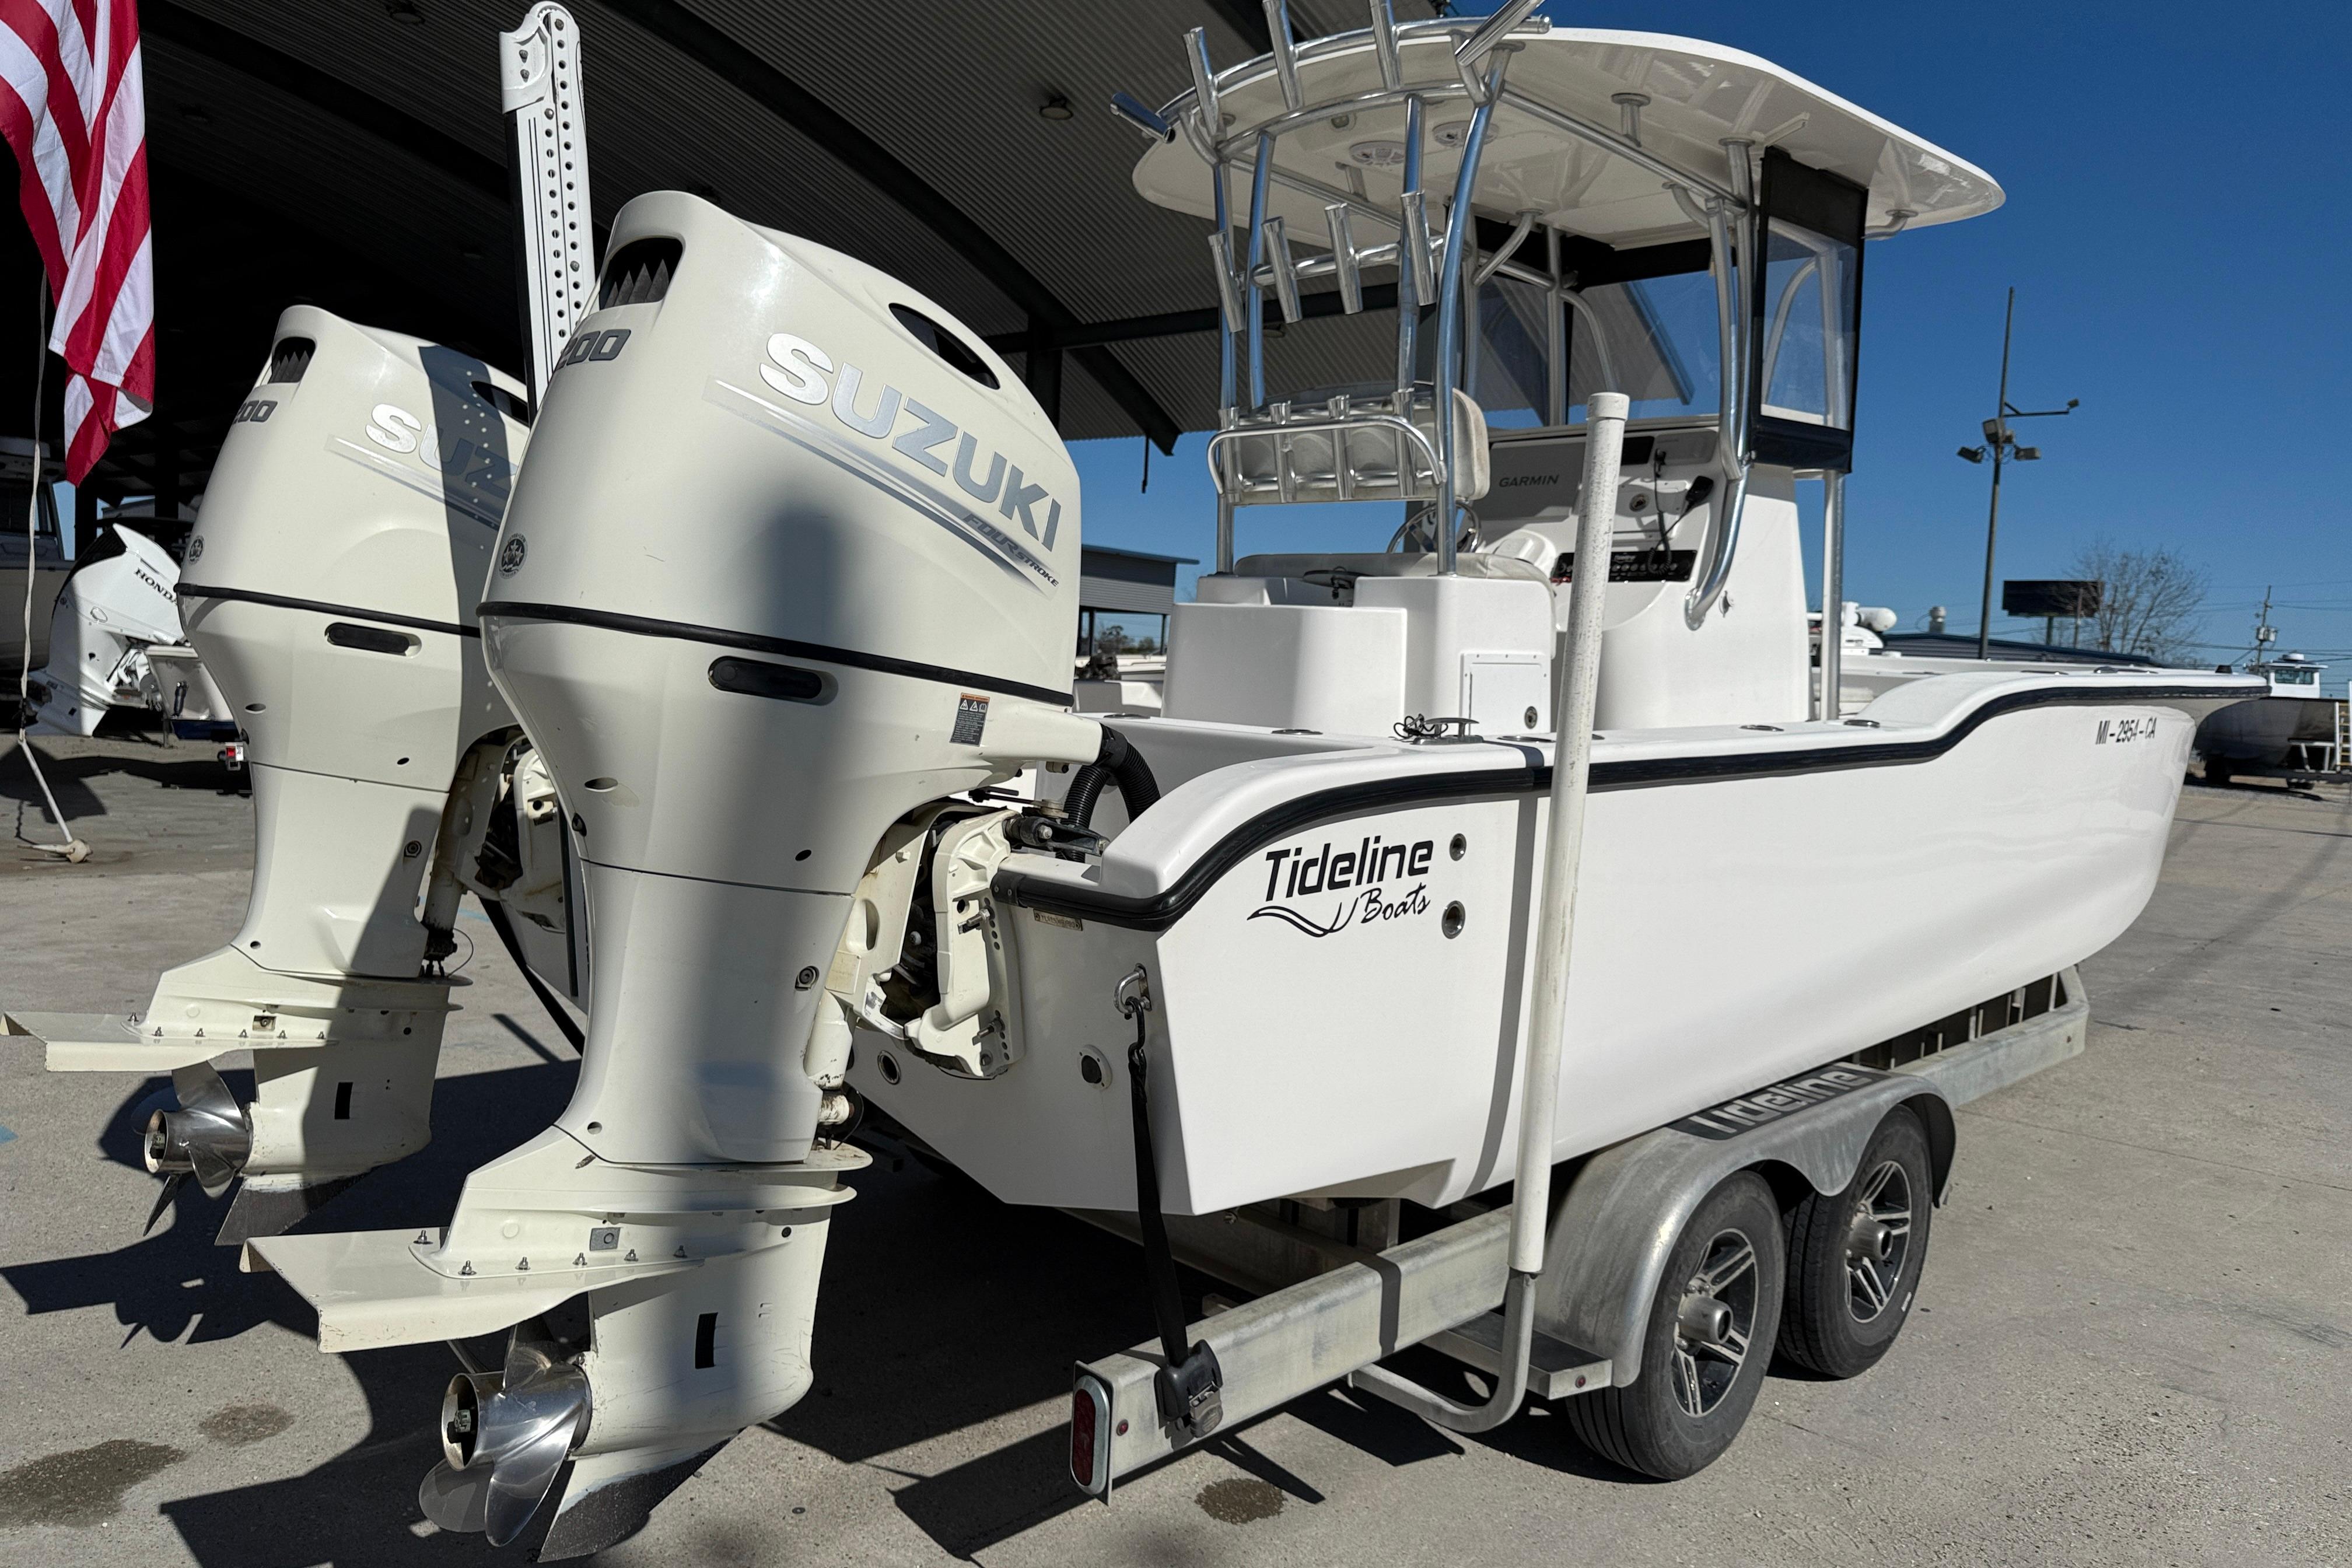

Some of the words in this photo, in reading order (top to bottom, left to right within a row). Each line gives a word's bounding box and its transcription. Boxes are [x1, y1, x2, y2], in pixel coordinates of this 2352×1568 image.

[759, 332, 1061, 552] SUZUKI
[1499, 474, 1560, 488] GARMIN
[963, 513, 1019, 554] FOUR
[1015, 552, 1059, 587] STROKE
[1265, 835, 1434, 902] Tideline
[1360, 882, 1431, 924] Boats
